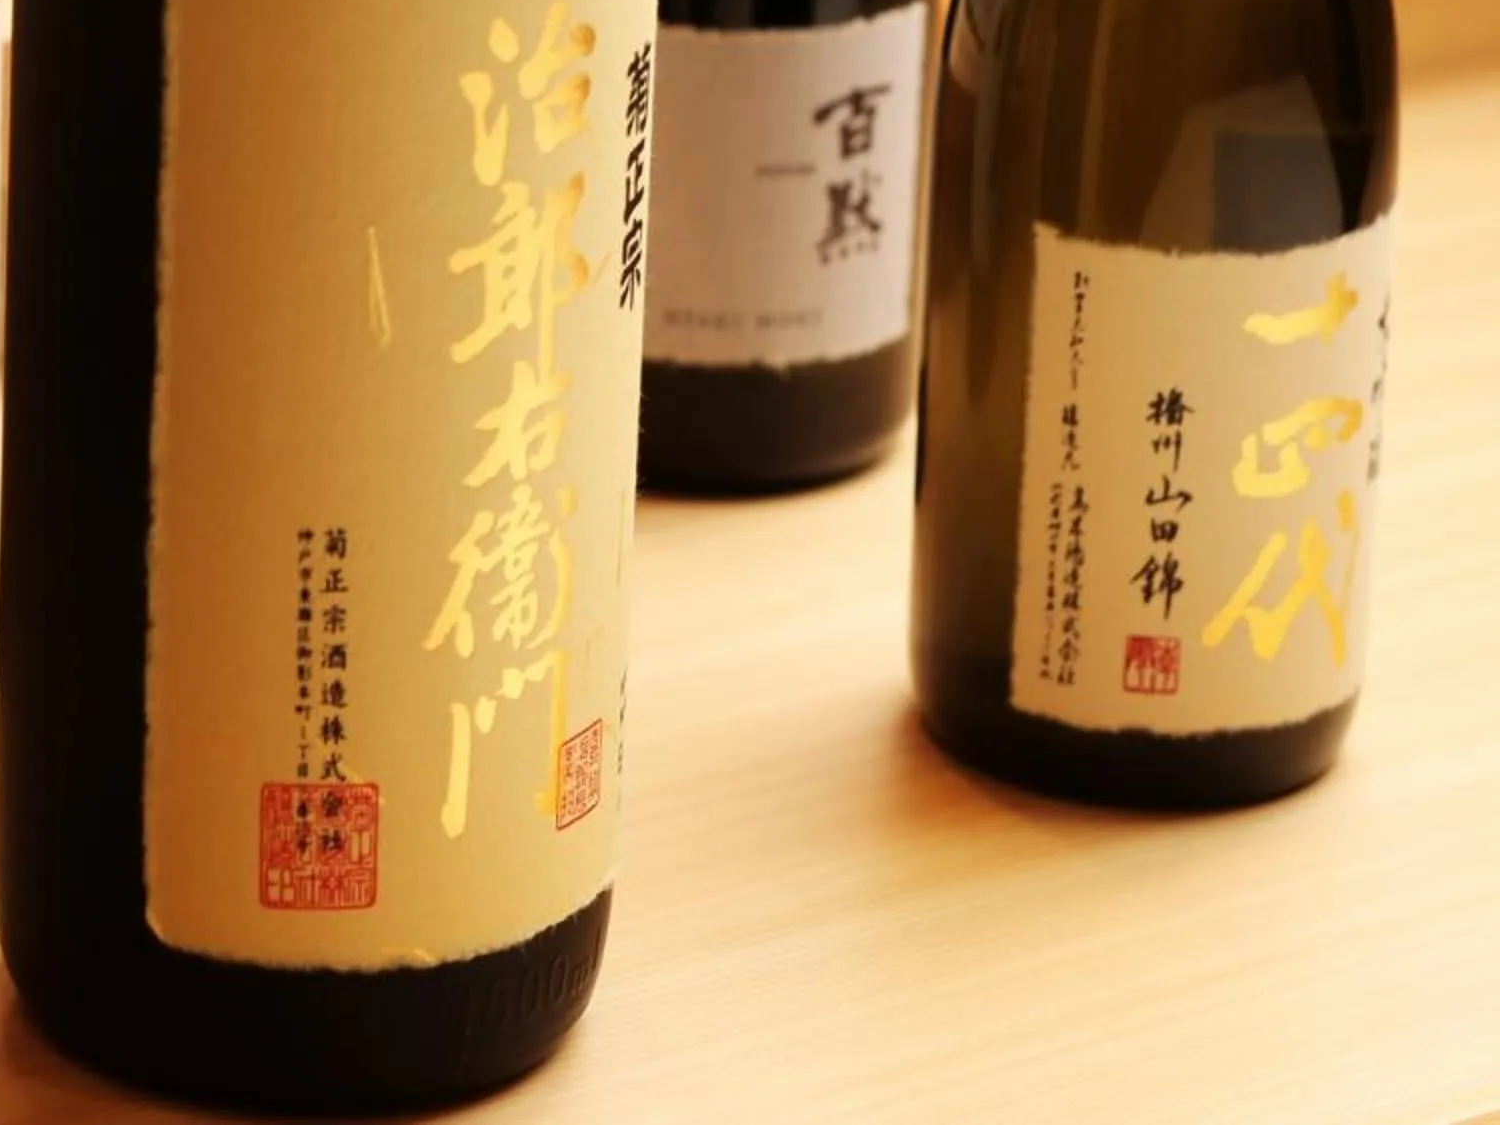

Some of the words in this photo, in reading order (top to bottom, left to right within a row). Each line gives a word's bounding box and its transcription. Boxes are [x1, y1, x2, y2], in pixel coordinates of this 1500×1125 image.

[423, 0, 598, 840] 治郎右衛門
[1130, 387, 1195, 621] 播州山田錦
[1202, 271, 1364, 667] 十四代
